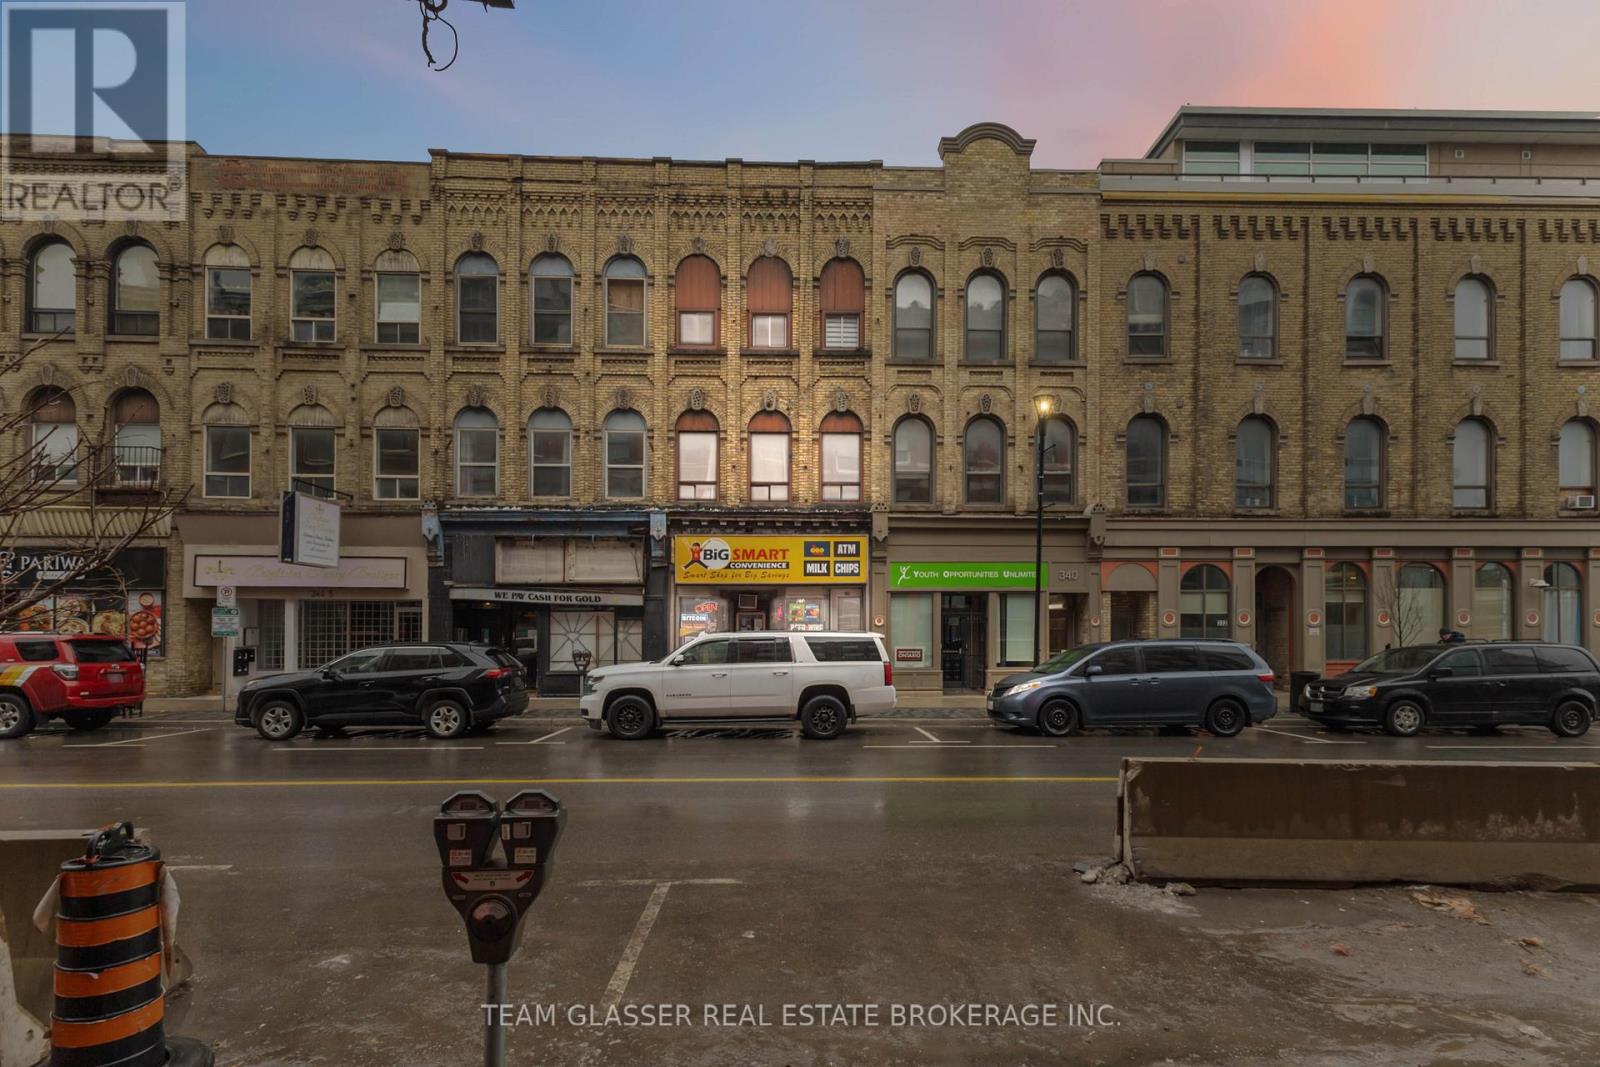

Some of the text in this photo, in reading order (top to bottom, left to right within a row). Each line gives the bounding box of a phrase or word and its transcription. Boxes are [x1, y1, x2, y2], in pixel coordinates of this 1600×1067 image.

[837, 543, 857, 554] ATM
[732, 548, 790, 561] SMART
[806, 562, 828, 574] MILK
[835, 562, 859, 574] CHIPS
[683, 571, 708, 579] Smart
[730, 571, 743, 580] for
[745, 571, 758, 580] Big
[913, 570, 1040, 578] YOUTH OPPORTUNITIES UNLIMITE
[1058, 570, 1079, 581] 340
[494, 591, 602, 603] WE PAY CASH FOR GOLD
